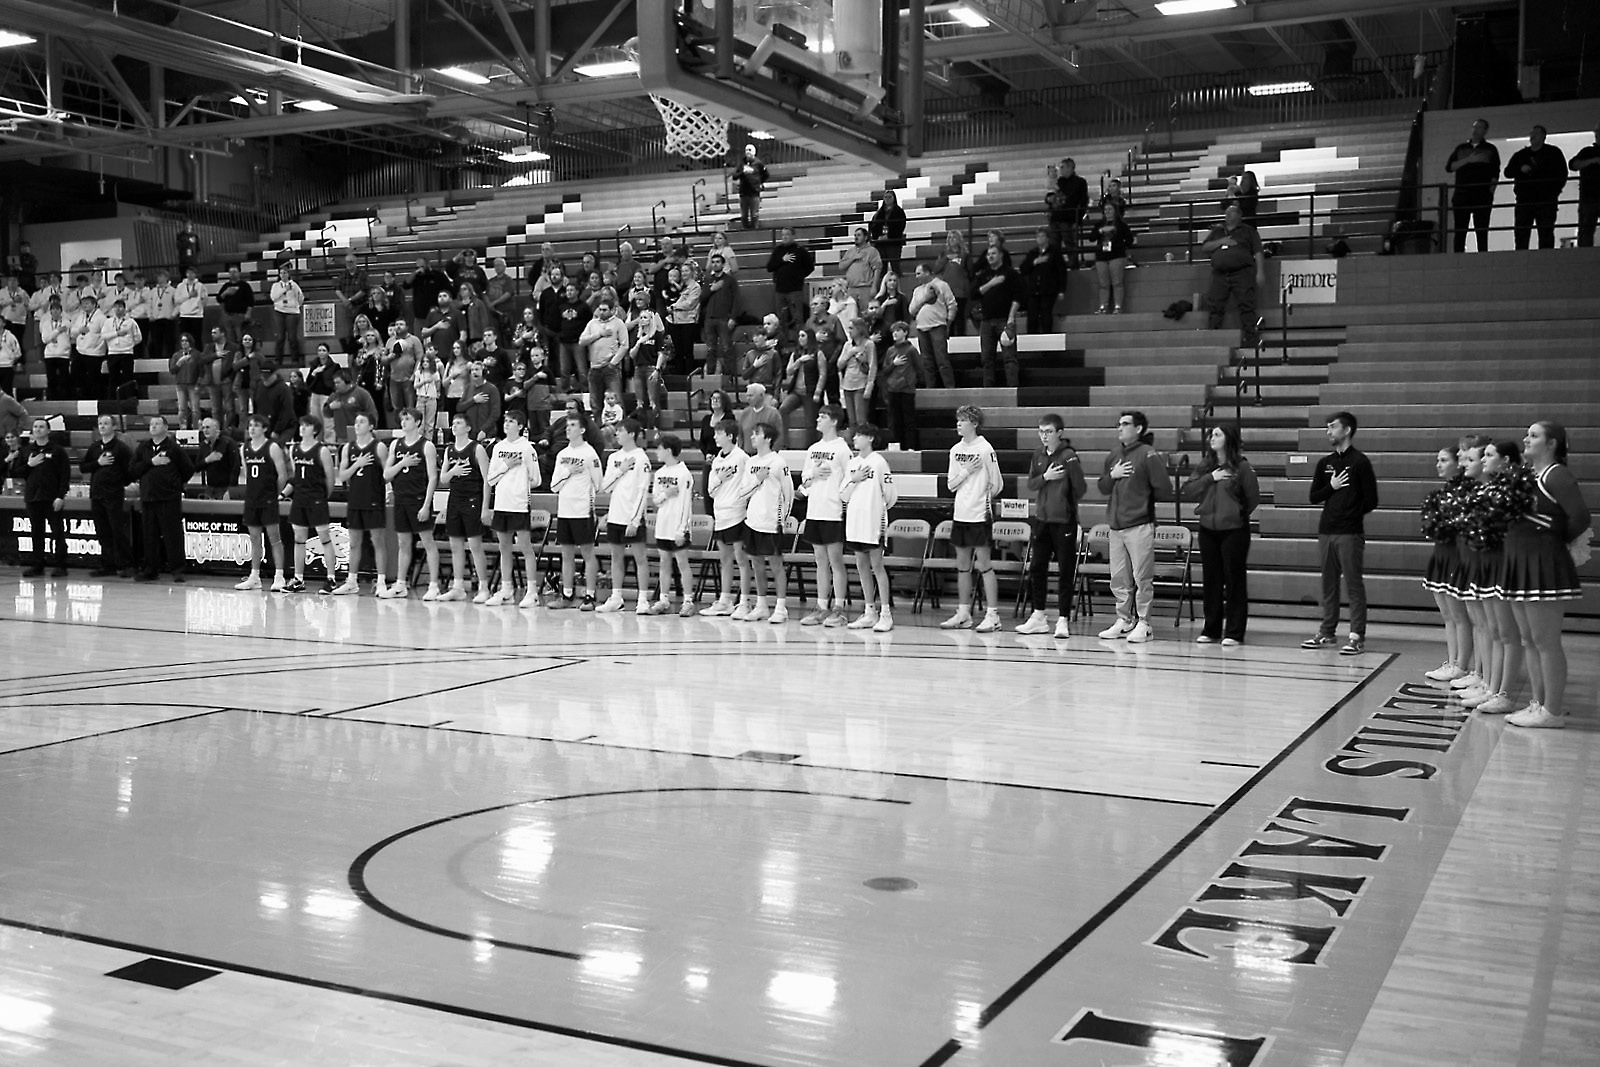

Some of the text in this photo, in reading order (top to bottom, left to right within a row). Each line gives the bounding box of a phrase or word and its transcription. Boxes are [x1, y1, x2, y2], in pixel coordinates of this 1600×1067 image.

[251, 465, 259, 478] 0
[300, 465, 306, 479] 1
[1004, 501, 1026, 510] Water
[187, 522, 238, 532] HOME OF THE
[893, 525, 924, 533] FIREBIRDS
[993, 527, 1025, 535] FIREBIRDS
[1324, 683, 1470, 779] DEVILS
[1152, 796, 1411, 965] LAKE
